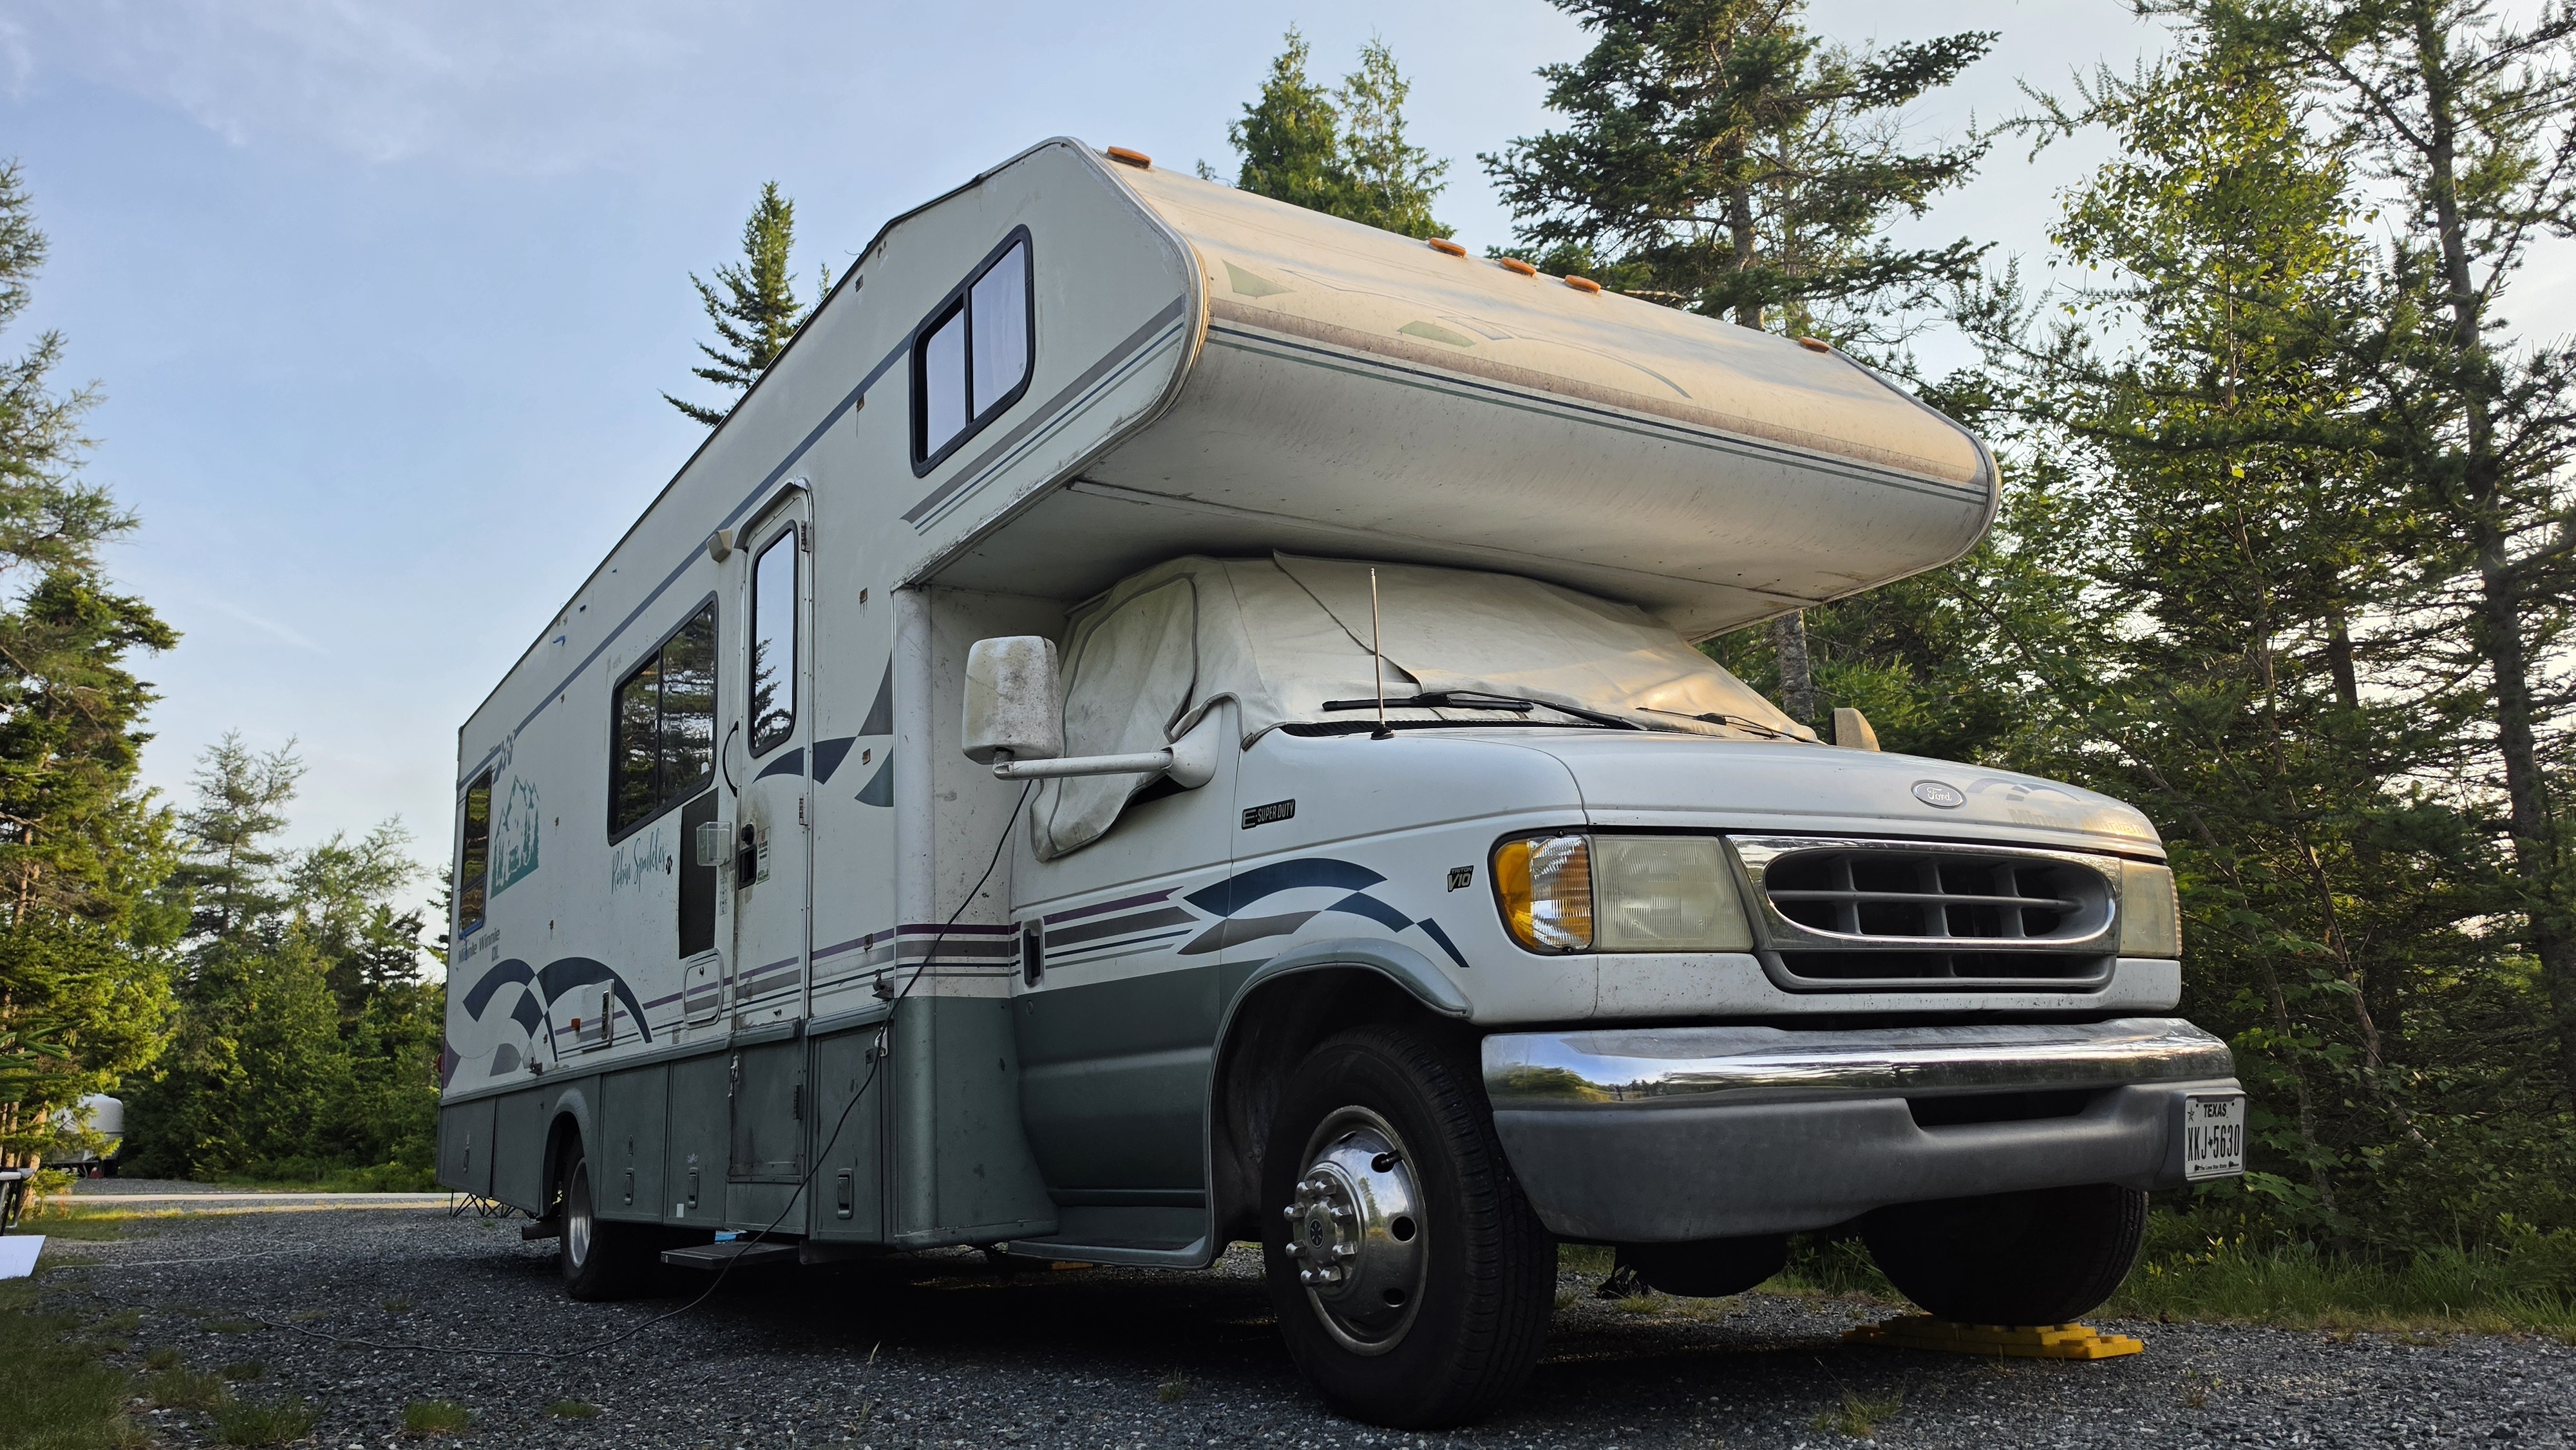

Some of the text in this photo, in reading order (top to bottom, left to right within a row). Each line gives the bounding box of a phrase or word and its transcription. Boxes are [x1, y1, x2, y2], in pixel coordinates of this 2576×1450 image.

[1927, 787, 1952, 801] Ford
[1278, 802, 1294, 818] DUTY
[1448, 873, 1471, 890] V10
[479, 927, 500, 952] Winnie
[2204, 1104, 2226, 1118] TEXAS
